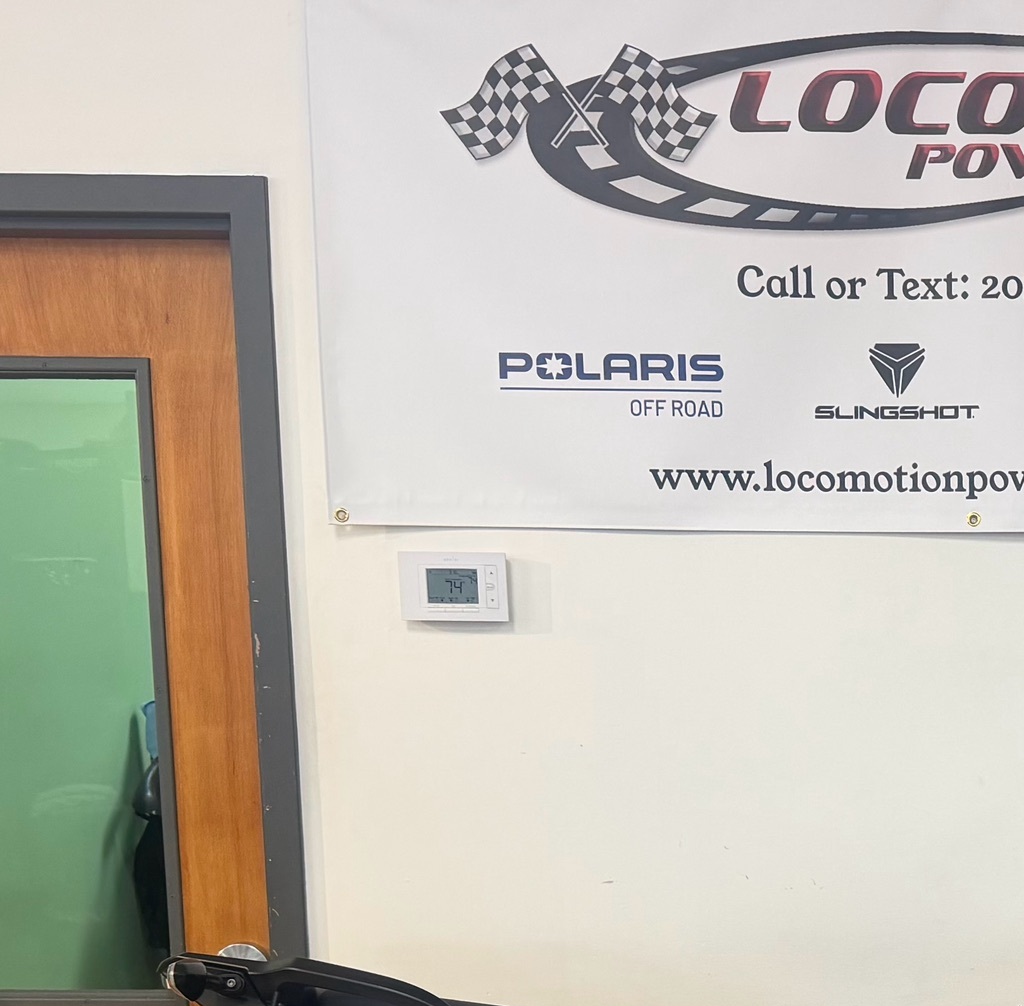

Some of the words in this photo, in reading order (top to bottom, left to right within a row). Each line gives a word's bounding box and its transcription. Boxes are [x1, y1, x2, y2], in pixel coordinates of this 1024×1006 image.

[736, 264, 816, 298] Call
[825, 275, 866, 300] or
[876, 267, 969, 301] Text:
[499, 352, 725, 383] POLARIS
[629, 399, 668, 417] OFF
[672, 400, 724, 418] ROAD
[814, 405, 980, 420] SLINGSHOT
[445, 580, 463, 594] 74
